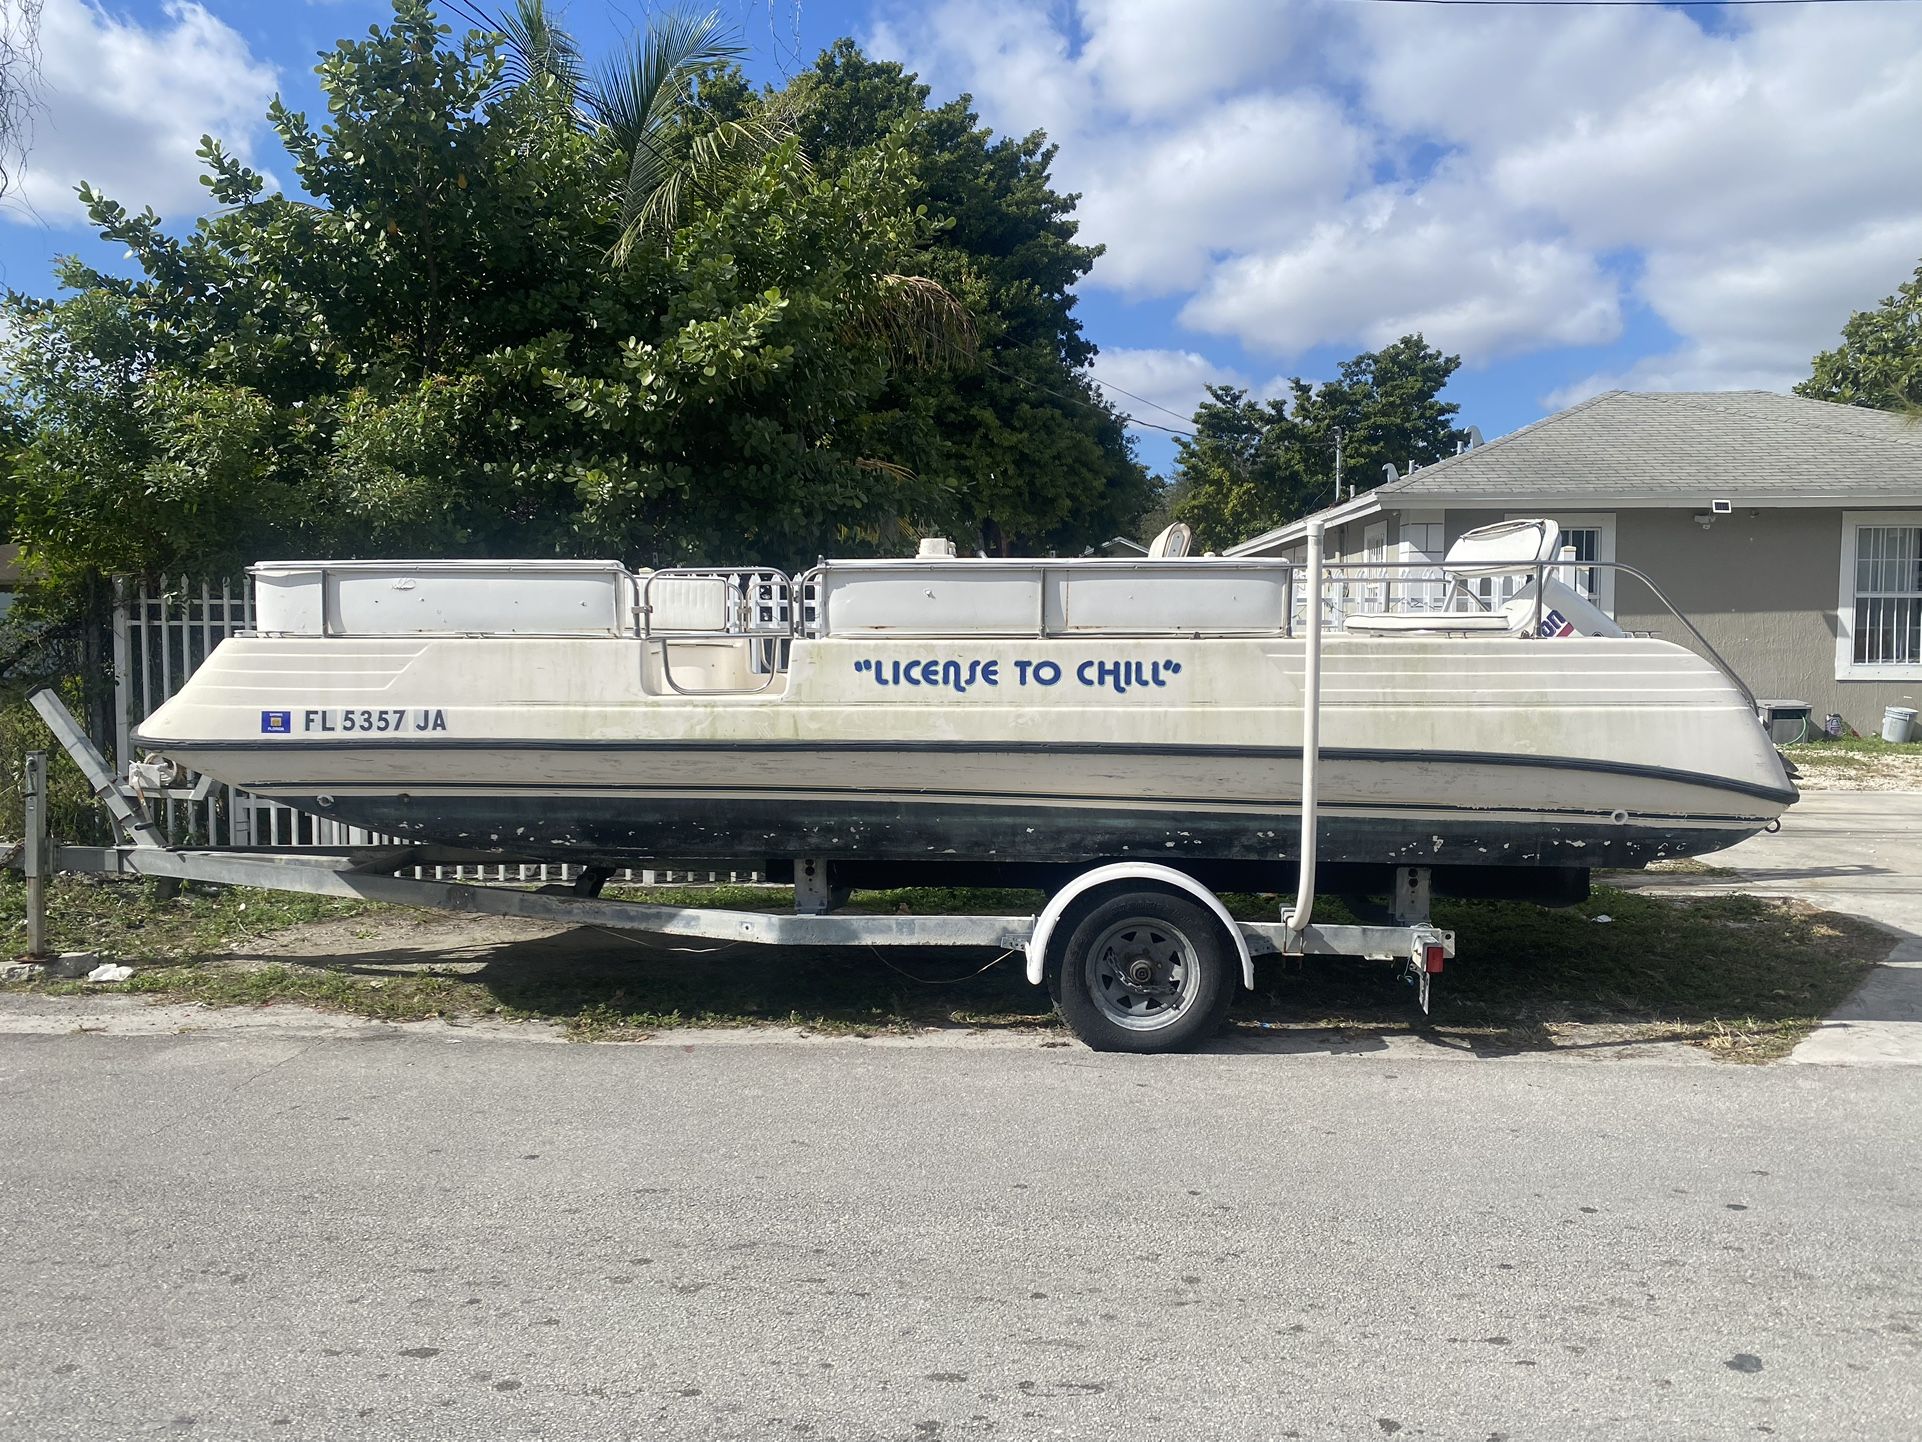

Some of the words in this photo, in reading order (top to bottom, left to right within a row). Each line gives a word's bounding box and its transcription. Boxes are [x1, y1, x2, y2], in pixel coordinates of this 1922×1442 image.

[854, 660, 998, 692] "LICENSE
[1014, 661, 1061, 685] TO
[1076, 660, 1181, 692] CHILL"
[305, 710, 335, 732] FL
[343, 710, 406, 732] 5357
[416, 710, 447, 731] JA
